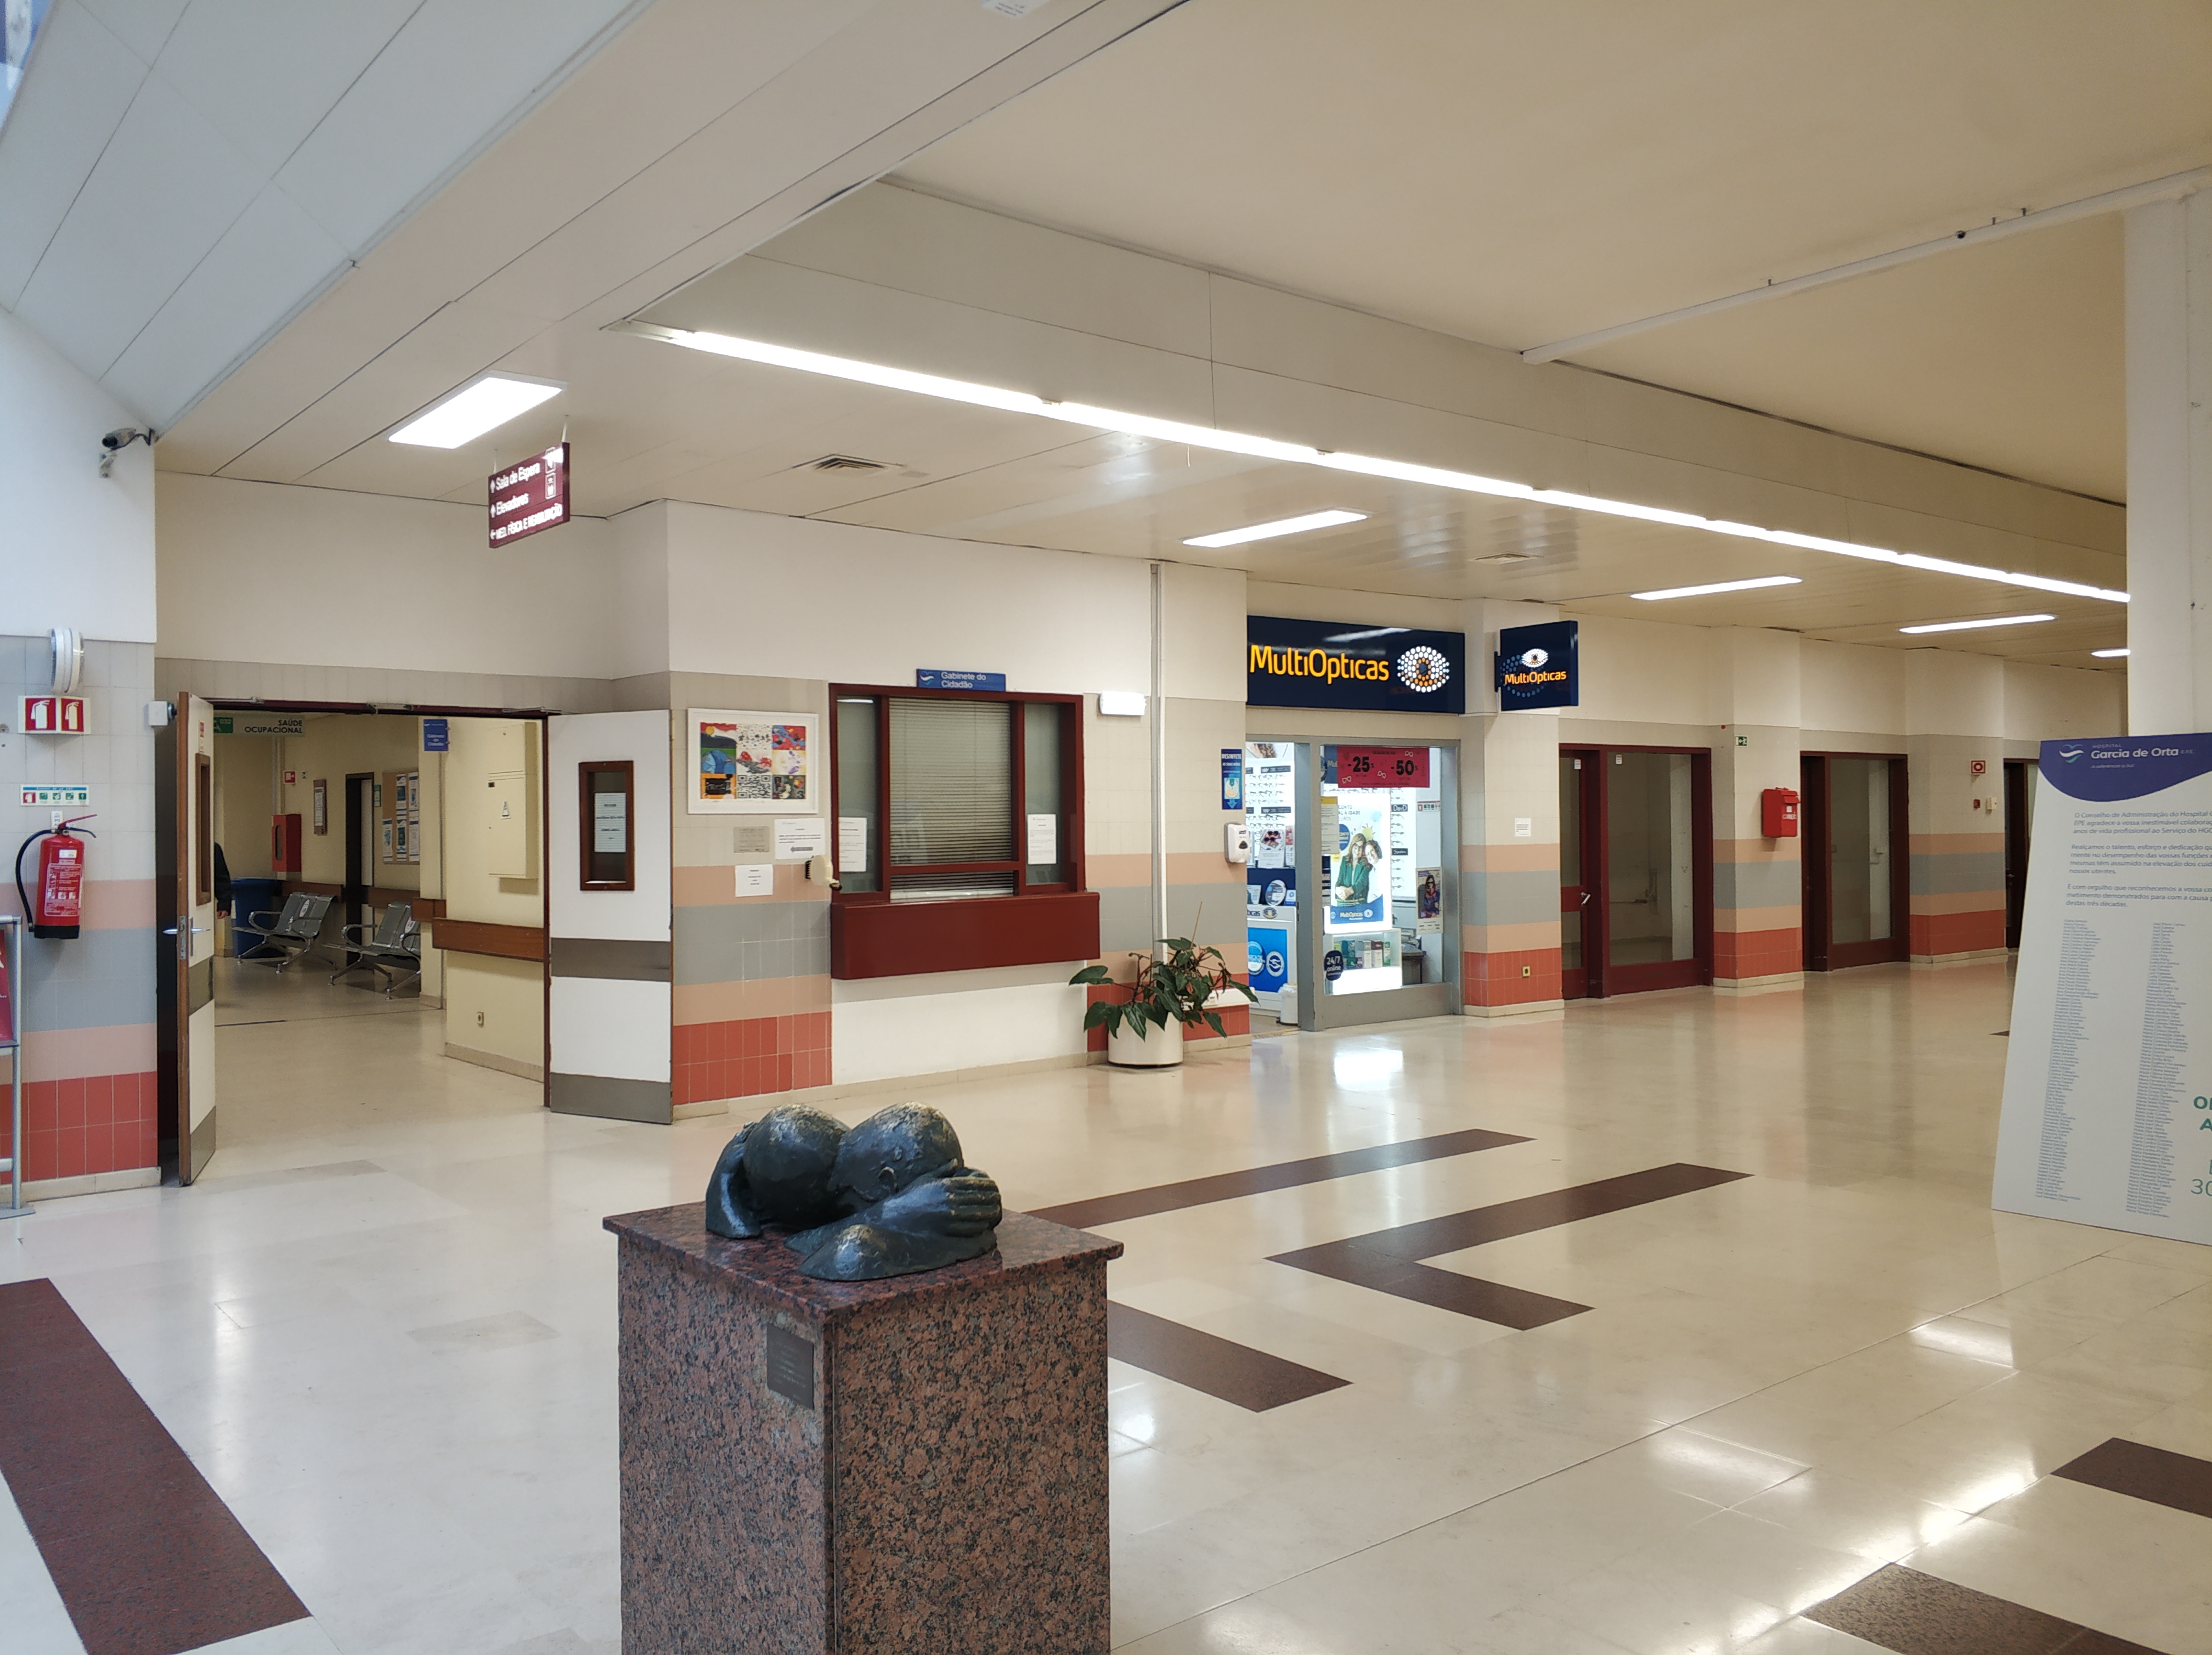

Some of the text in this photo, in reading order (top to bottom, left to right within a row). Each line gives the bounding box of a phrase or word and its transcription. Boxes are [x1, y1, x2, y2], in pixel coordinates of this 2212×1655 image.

[496, 463, 540, 491] Sala de Espera
[496, 493, 529, 515] Elevadores
[1250, 645, 1389, 684] MultiOpticas
[941, 672, 975, 680] Gabinete
[1505, 671, 1566, 685] MultiOpticas
[941, 680, 973, 688] Cidadão
[2091, 748, 2130, 759] Garcia
[2132, 748, 2148, 757] de
[2151, 747, 2179, 757] Orta
[1327, 956, 1340, 965] 24/7
[2193, 1096, 2212, 1110] O
